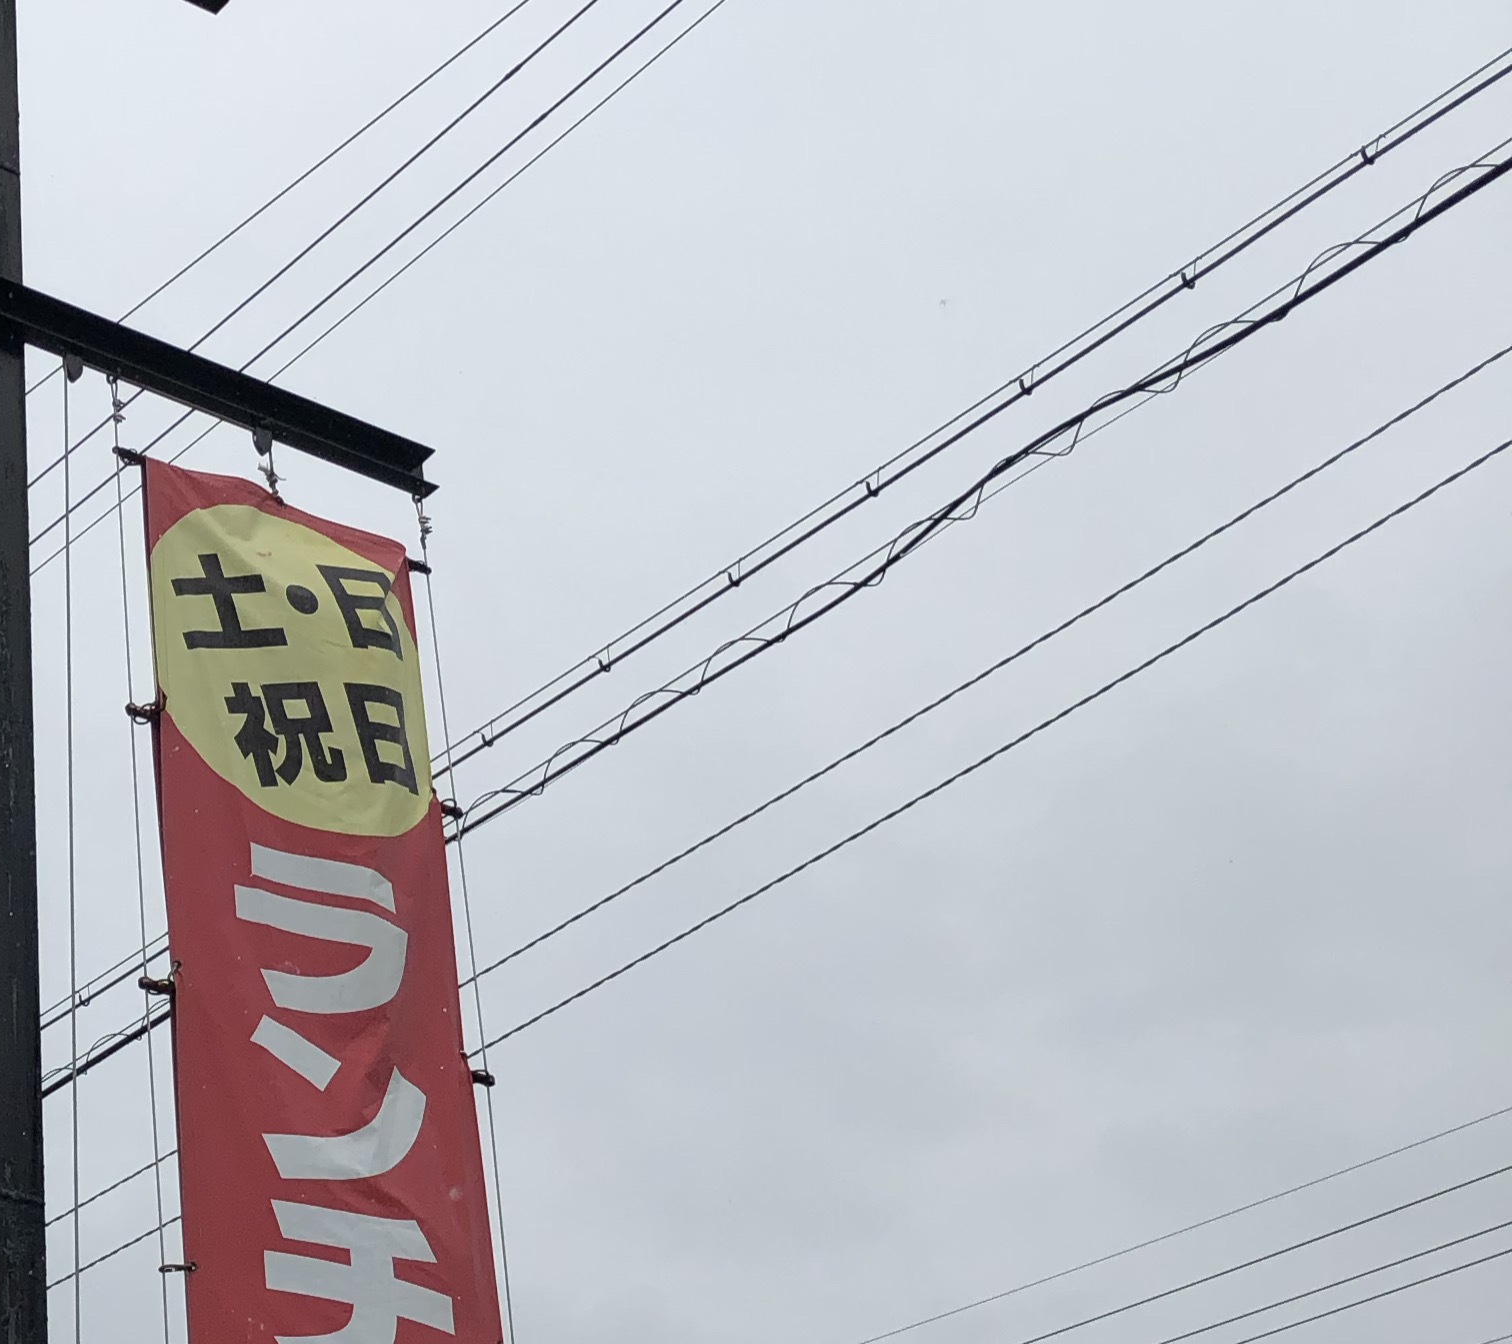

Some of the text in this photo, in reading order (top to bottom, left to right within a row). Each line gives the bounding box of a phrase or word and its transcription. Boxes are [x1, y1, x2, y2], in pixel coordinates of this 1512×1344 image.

[171, 552, 402, 663] 土・日
[224, 679, 420, 796] 祝日
